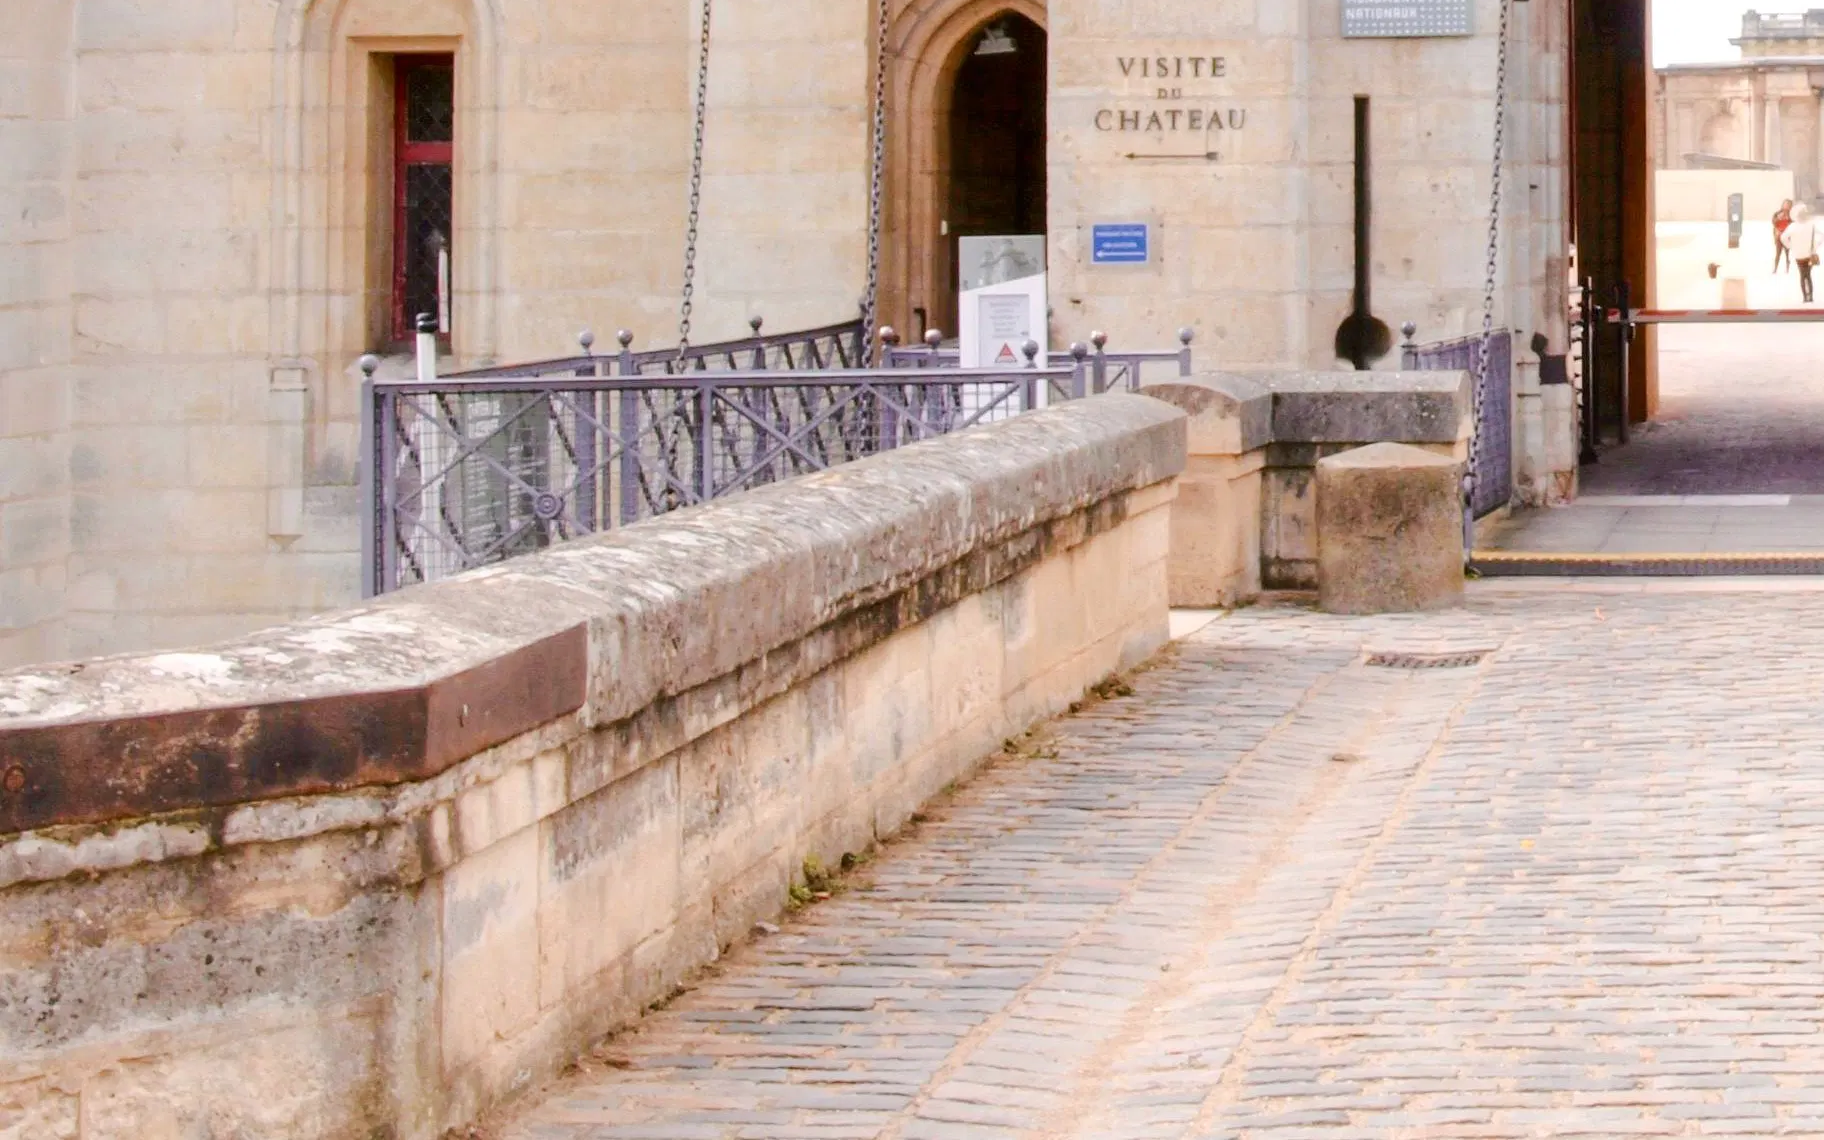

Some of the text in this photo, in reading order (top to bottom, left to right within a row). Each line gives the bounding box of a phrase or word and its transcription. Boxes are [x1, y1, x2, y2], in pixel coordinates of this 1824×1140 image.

[1346, 7, 1417, 20] NATIONAUX
[1117, 56, 1226, 78] VISITE
[1157, 87, 1182, 100] DU
[1094, 109, 1246, 132] CHATEAU
